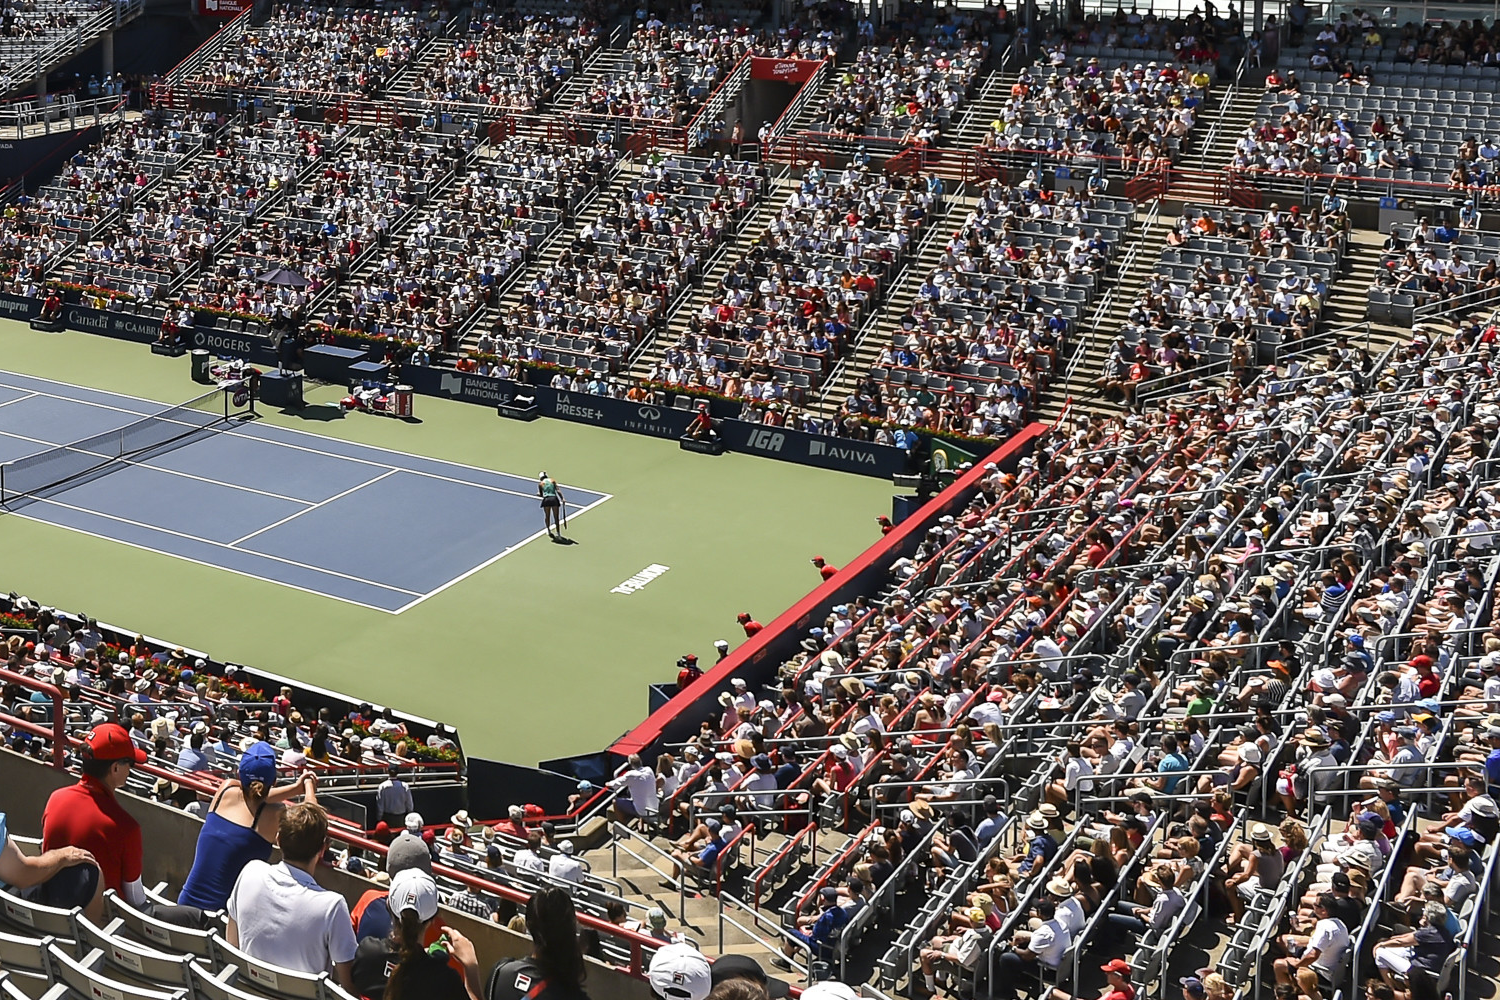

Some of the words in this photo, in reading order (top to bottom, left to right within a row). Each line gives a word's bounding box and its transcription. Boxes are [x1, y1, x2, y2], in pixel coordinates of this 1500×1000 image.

[218, 4, 244, 12] NATIONALE
[69, 310, 109, 329] Canada
[124, 321, 161, 337] CAMBRI
[207, 335, 251, 353] ROGERS
[465, 377, 499, 391] BANQUE
[233, 392, 250, 404] WTA
[464, 386, 510, 402] NATIONALE
[557, 392, 571, 405] LA
[556, 403, 604, 420] PRESSE+
[624, 419, 673, 434] INFINITI
[746, 428, 785, 452] IGA
[828, 447, 877, 465] AVIVA
